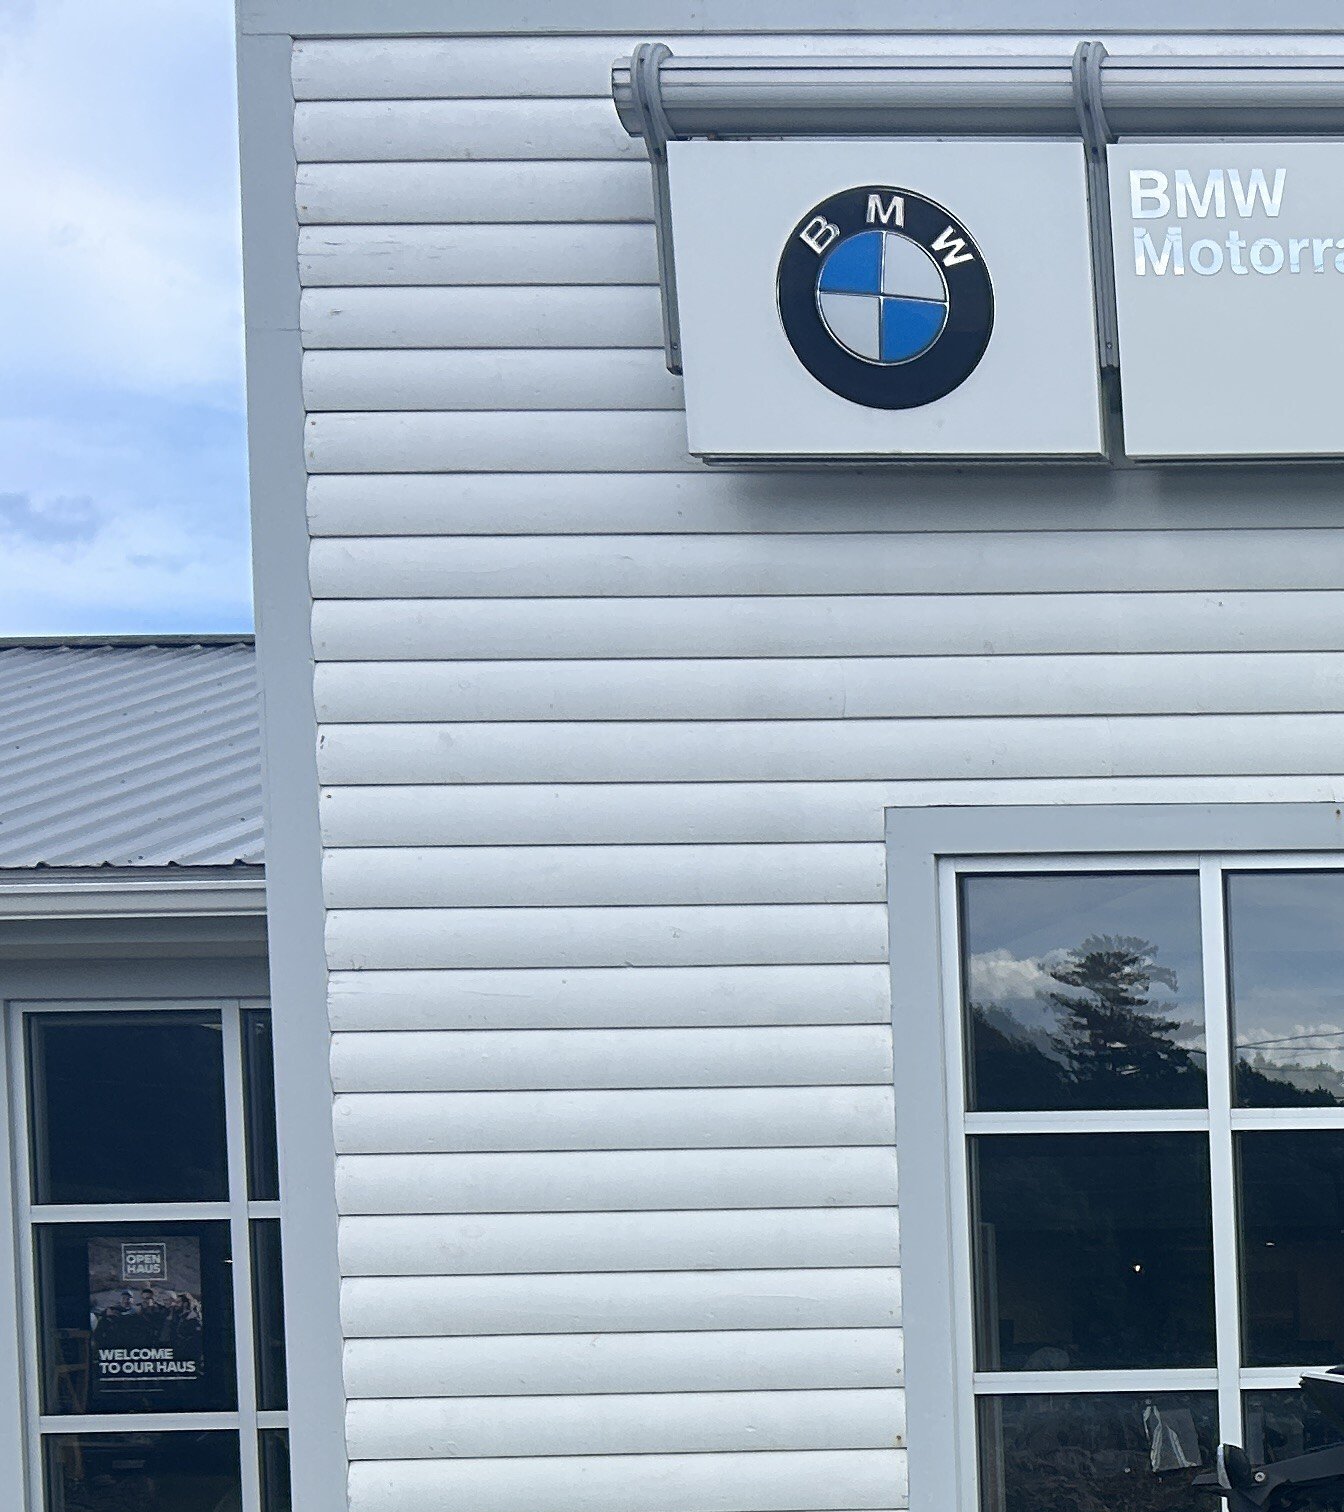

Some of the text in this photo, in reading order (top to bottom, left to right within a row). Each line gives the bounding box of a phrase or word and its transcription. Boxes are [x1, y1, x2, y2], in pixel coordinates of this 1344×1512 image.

[1128, 167, 1287, 220] BMW
[799, 193, 975, 268] BMW
[126, 1254, 161, 1264] OPEN
[127, 1264, 161, 1274] HAUS
[99, 1348, 173, 1360] WELCOME
[99, 1360, 197, 1374] TO OUR HAUS
